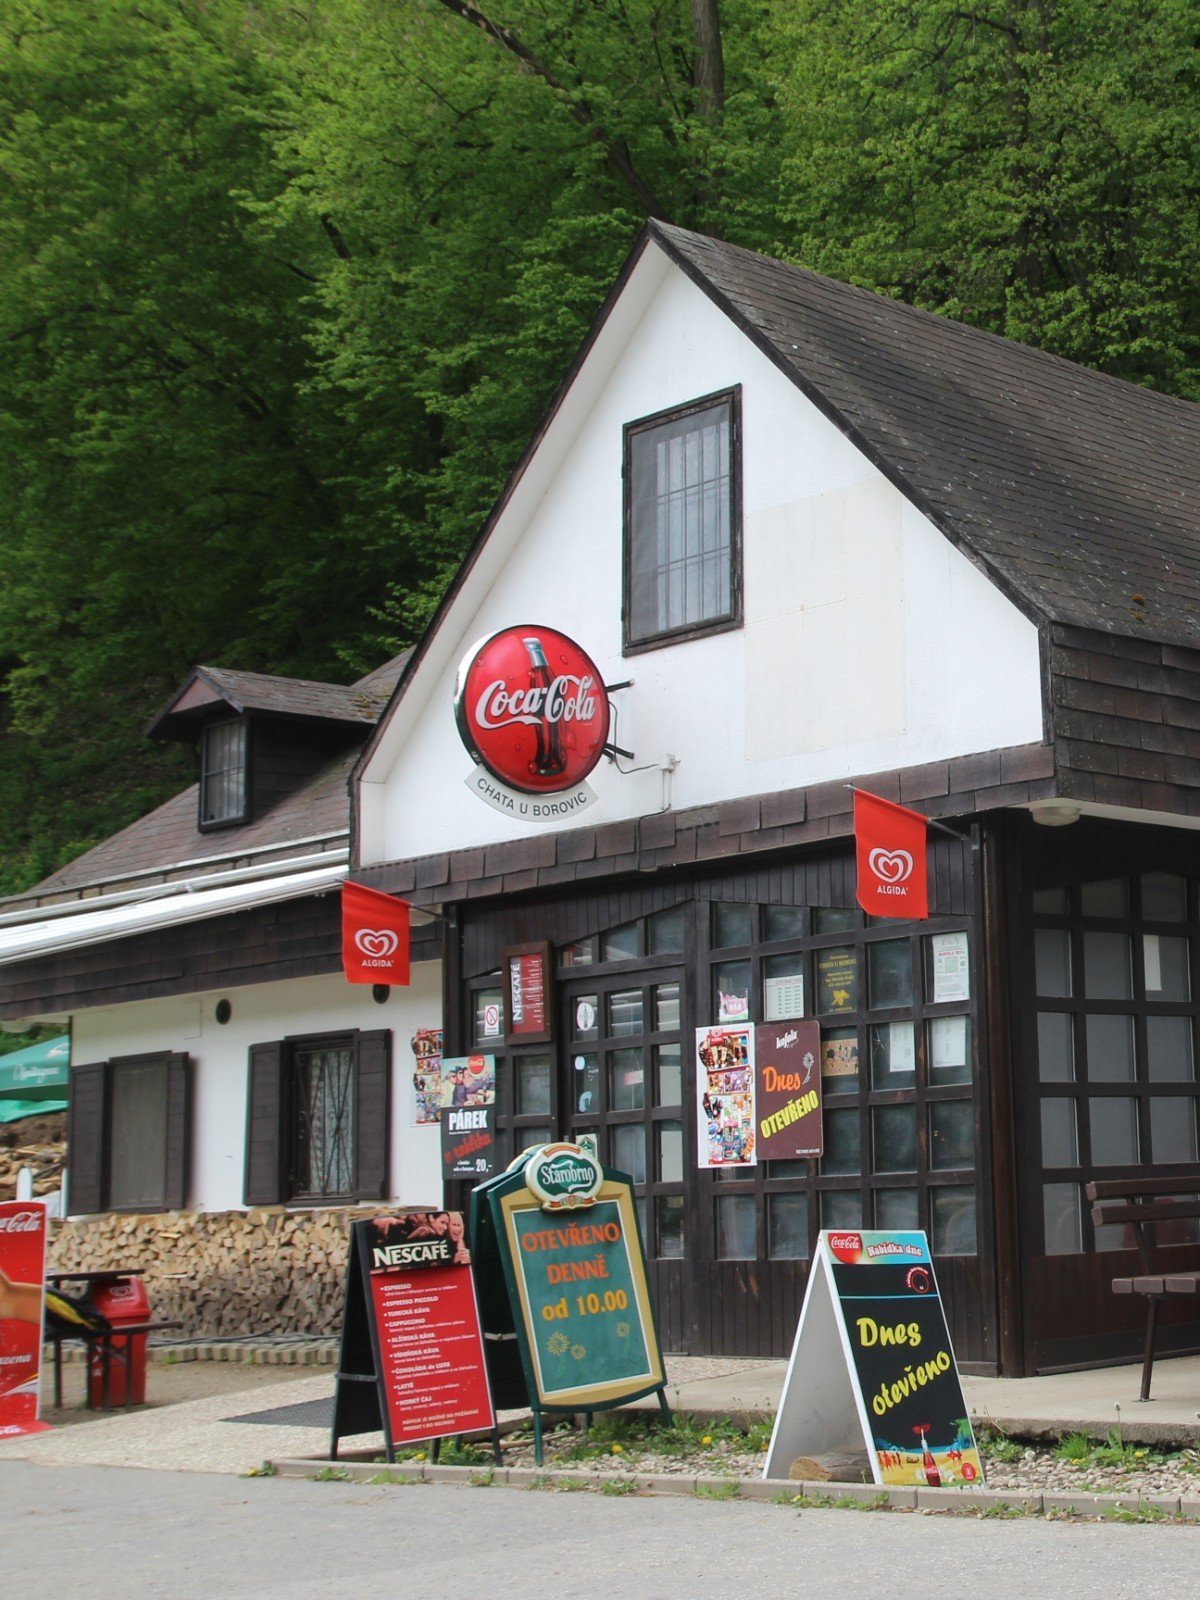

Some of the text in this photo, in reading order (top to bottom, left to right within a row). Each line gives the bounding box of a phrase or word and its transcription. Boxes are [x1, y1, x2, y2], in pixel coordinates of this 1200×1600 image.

[475, 674, 596, 729] Coca-Cola
[477, 778, 587, 817] CHATA U BOROVIC
[877, 884, 907, 895] ALGIDA
[361, 959, 393, 967] ALGIDA
[762, 1066, 801, 1093] Dnes
[449, 1109, 488, 1131] PÁREK
[760, 1089, 820, 1139] OTEVŘENO
[476, 1158, 493, 1172] 20,-
[541, 1159, 595, 1192] Starobrno
[522, 1222, 620, 1253] OTEVŘENO
[866, 1241, 923, 1257] Nabídka dne
[372, 1239, 450, 1268] NESCAFÉ
[546, 1254, 609, 1285] DENNĚ
[384, 1283, 412, 1291] ESPRESSO
[386, 1296, 438, 1307] ESPRESSO PICCOLO
[414, 1307, 430, 1315] KÁVA
[541, 1289, 628, 1321] od 10.00
[389, 1318, 425, 1327] CAPPUCCINO
[856, 1317, 922, 1347] Dnes
[872, 1350, 950, 1416] otevřeno
